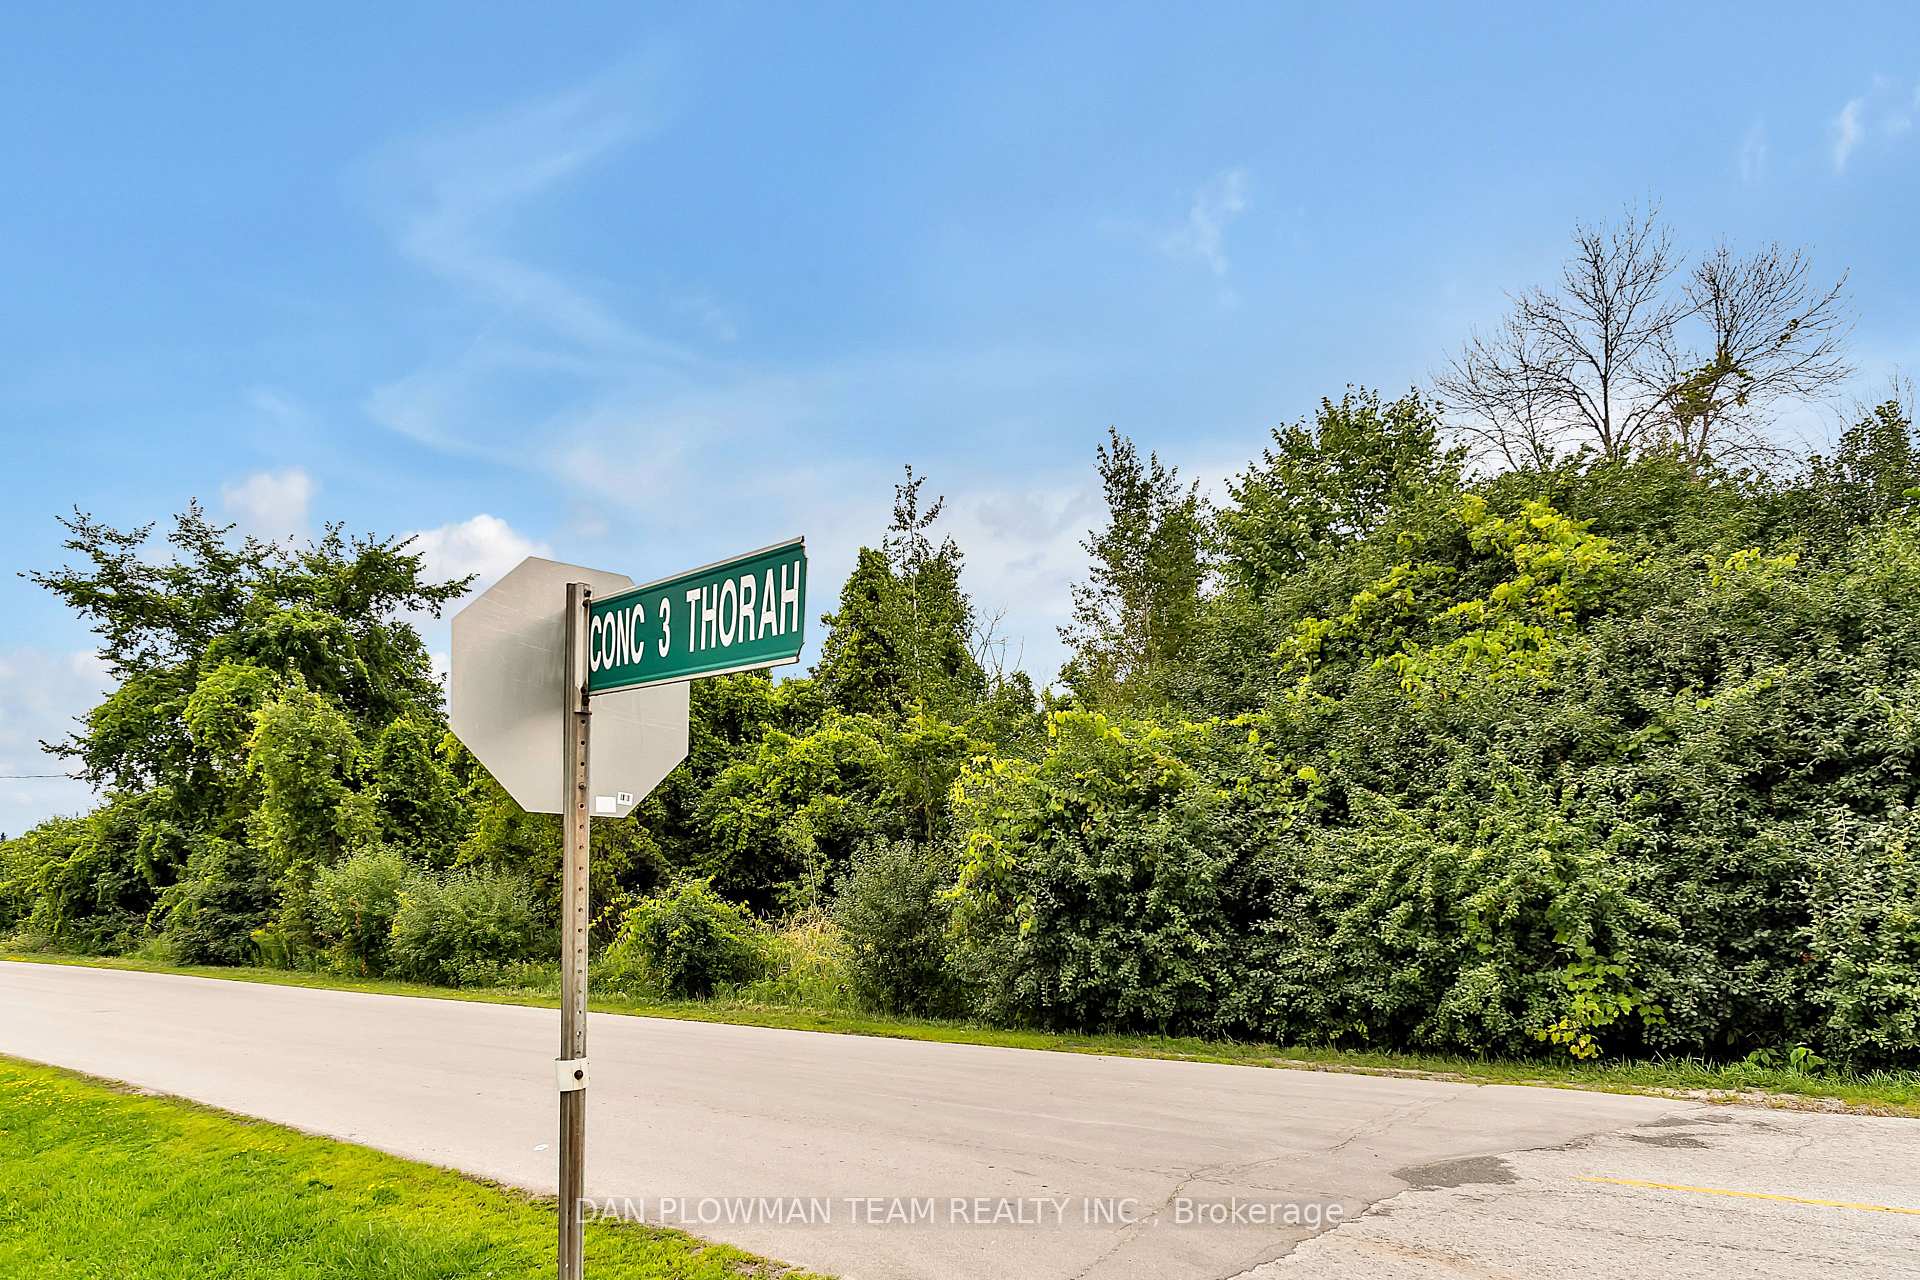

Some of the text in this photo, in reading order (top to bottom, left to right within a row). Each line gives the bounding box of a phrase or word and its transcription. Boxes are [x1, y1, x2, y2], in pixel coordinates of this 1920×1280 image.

[589, 560, 800, 672] CONC 3 THORAH
